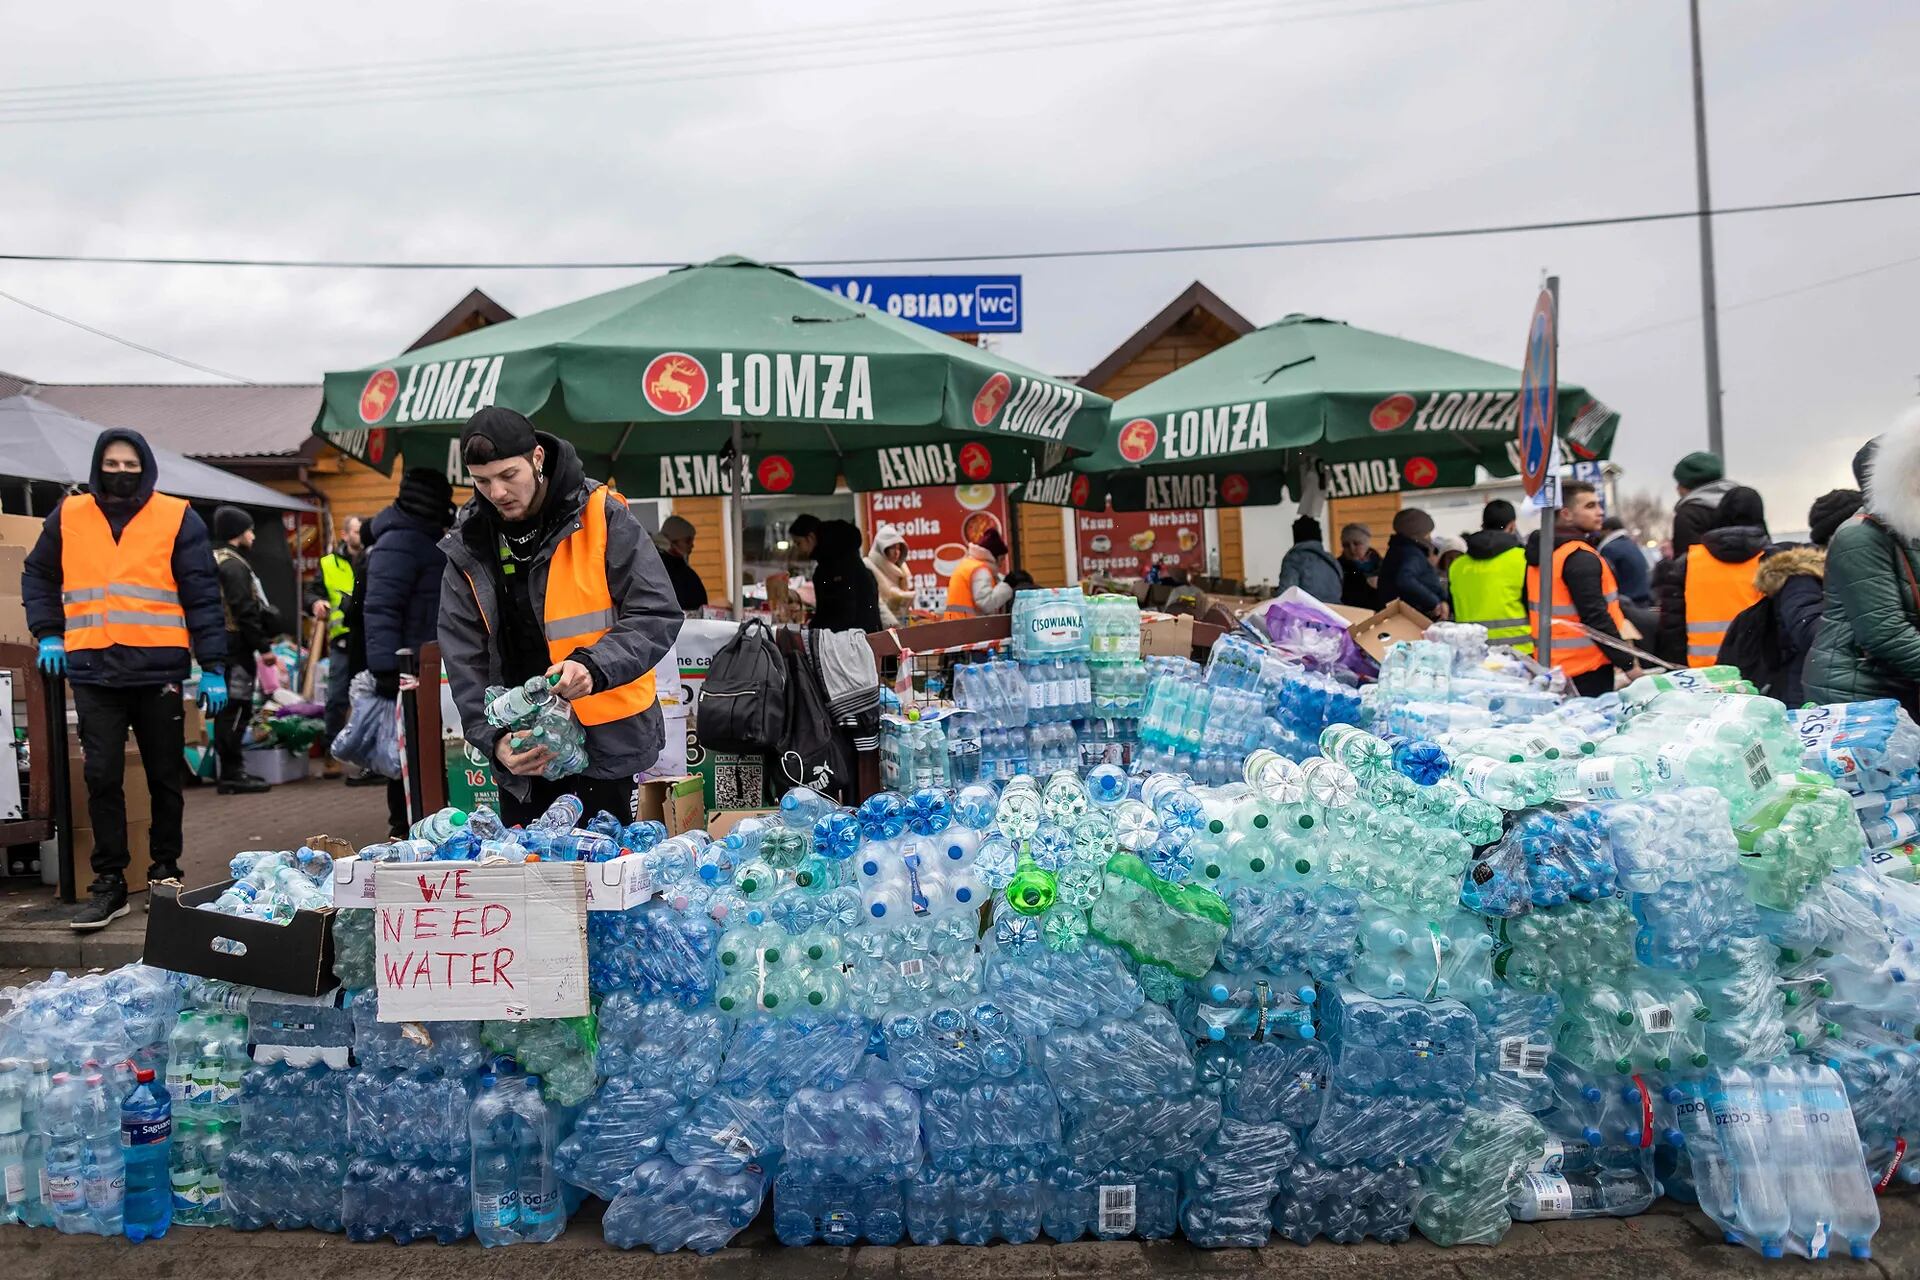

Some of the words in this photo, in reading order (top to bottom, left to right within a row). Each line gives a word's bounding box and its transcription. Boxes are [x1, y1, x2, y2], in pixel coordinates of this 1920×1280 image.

[887, 293, 974, 317] OBIADY
[980, 297, 1013, 313] WC
[395, 355, 505, 423] ŁOMŻA
[717, 352, 874, 420] ŁOMŻA
[999, 377, 1083, 440] ŁOMŻA
[1162, 401, 1269, 459] ŁOMŻA
[1080, 516, 1114, 531] Kawa
[1150, 513, 1198, 527] Herbata
[1083, 556, 1139, 572] Espresso
[1031, 615, 1084, 633] CISOWIANKA
[465, 769, 486, 786] 16
[417, 869, 475, 903] WE
[382, 903, 512, 943] NEED
[383, 947, 514, 990] WATER
